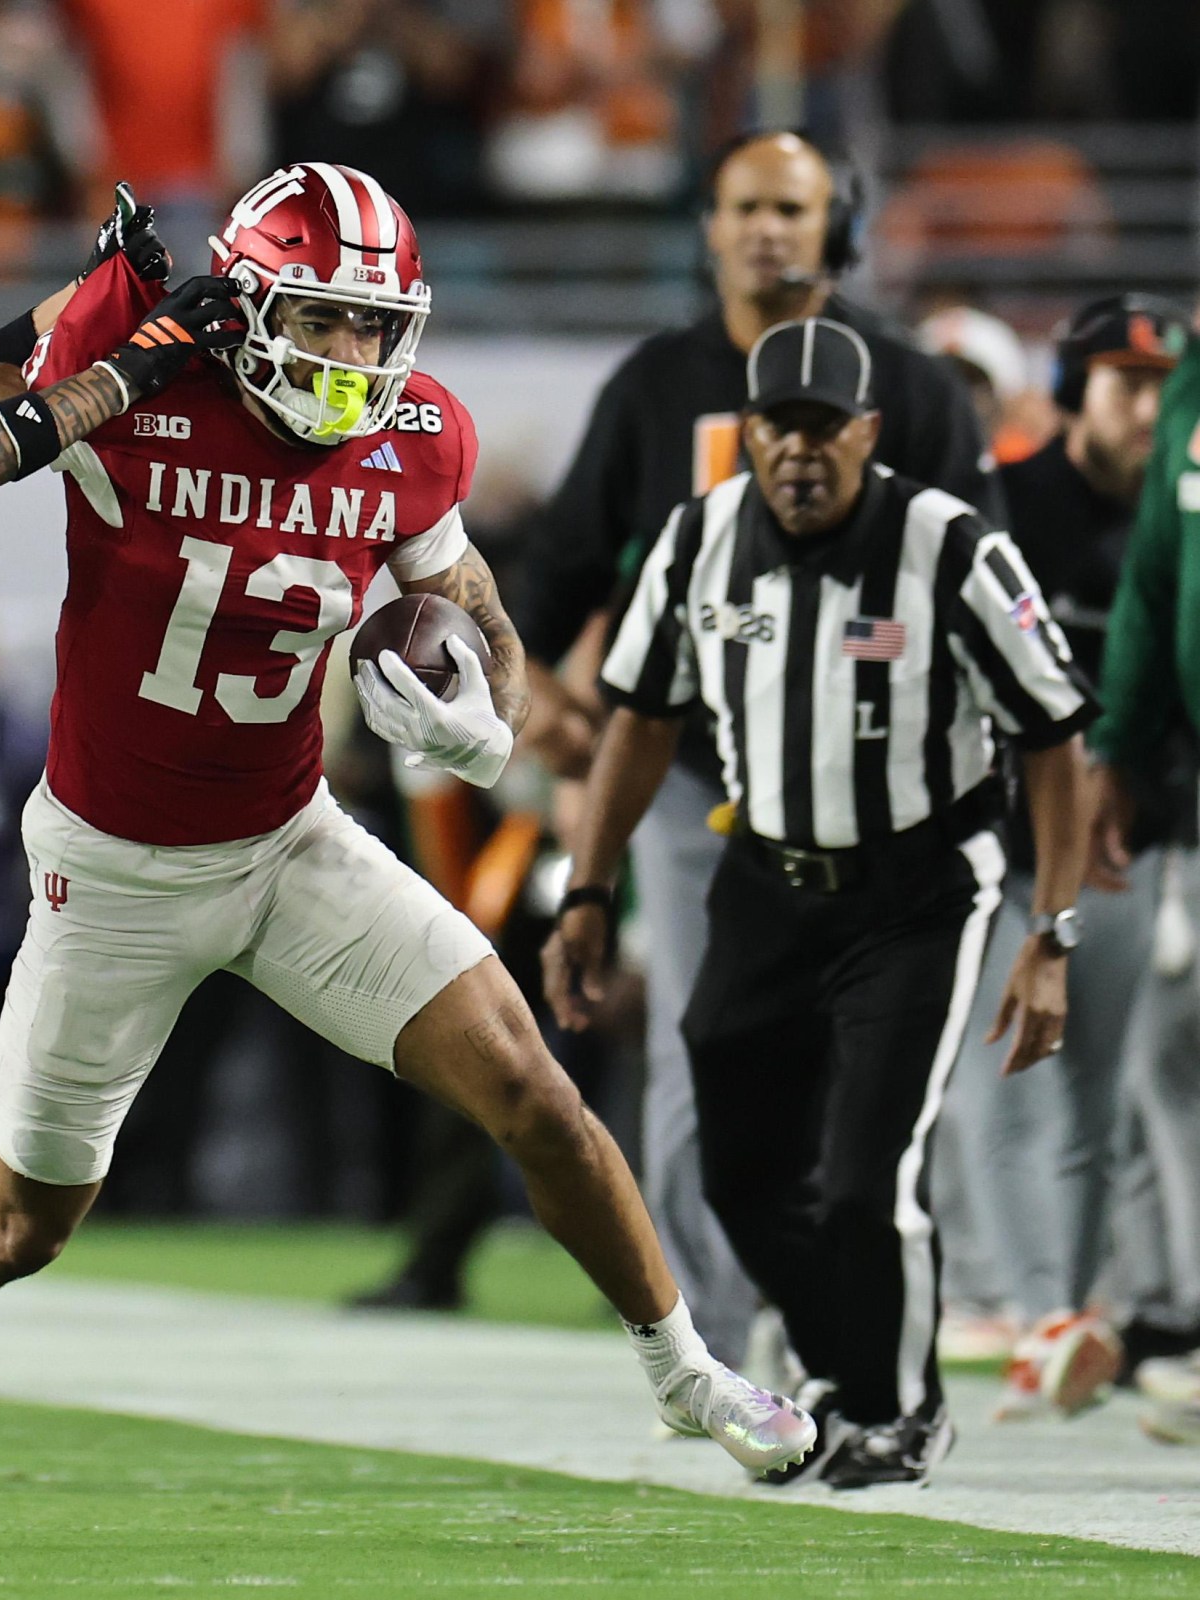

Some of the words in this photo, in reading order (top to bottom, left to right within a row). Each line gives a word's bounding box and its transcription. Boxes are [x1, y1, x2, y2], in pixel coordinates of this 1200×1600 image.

[382, 401, 444, 435] 26
[145, 461, 396, 542] INDIANA
[137, 535, 353, 724] 13
